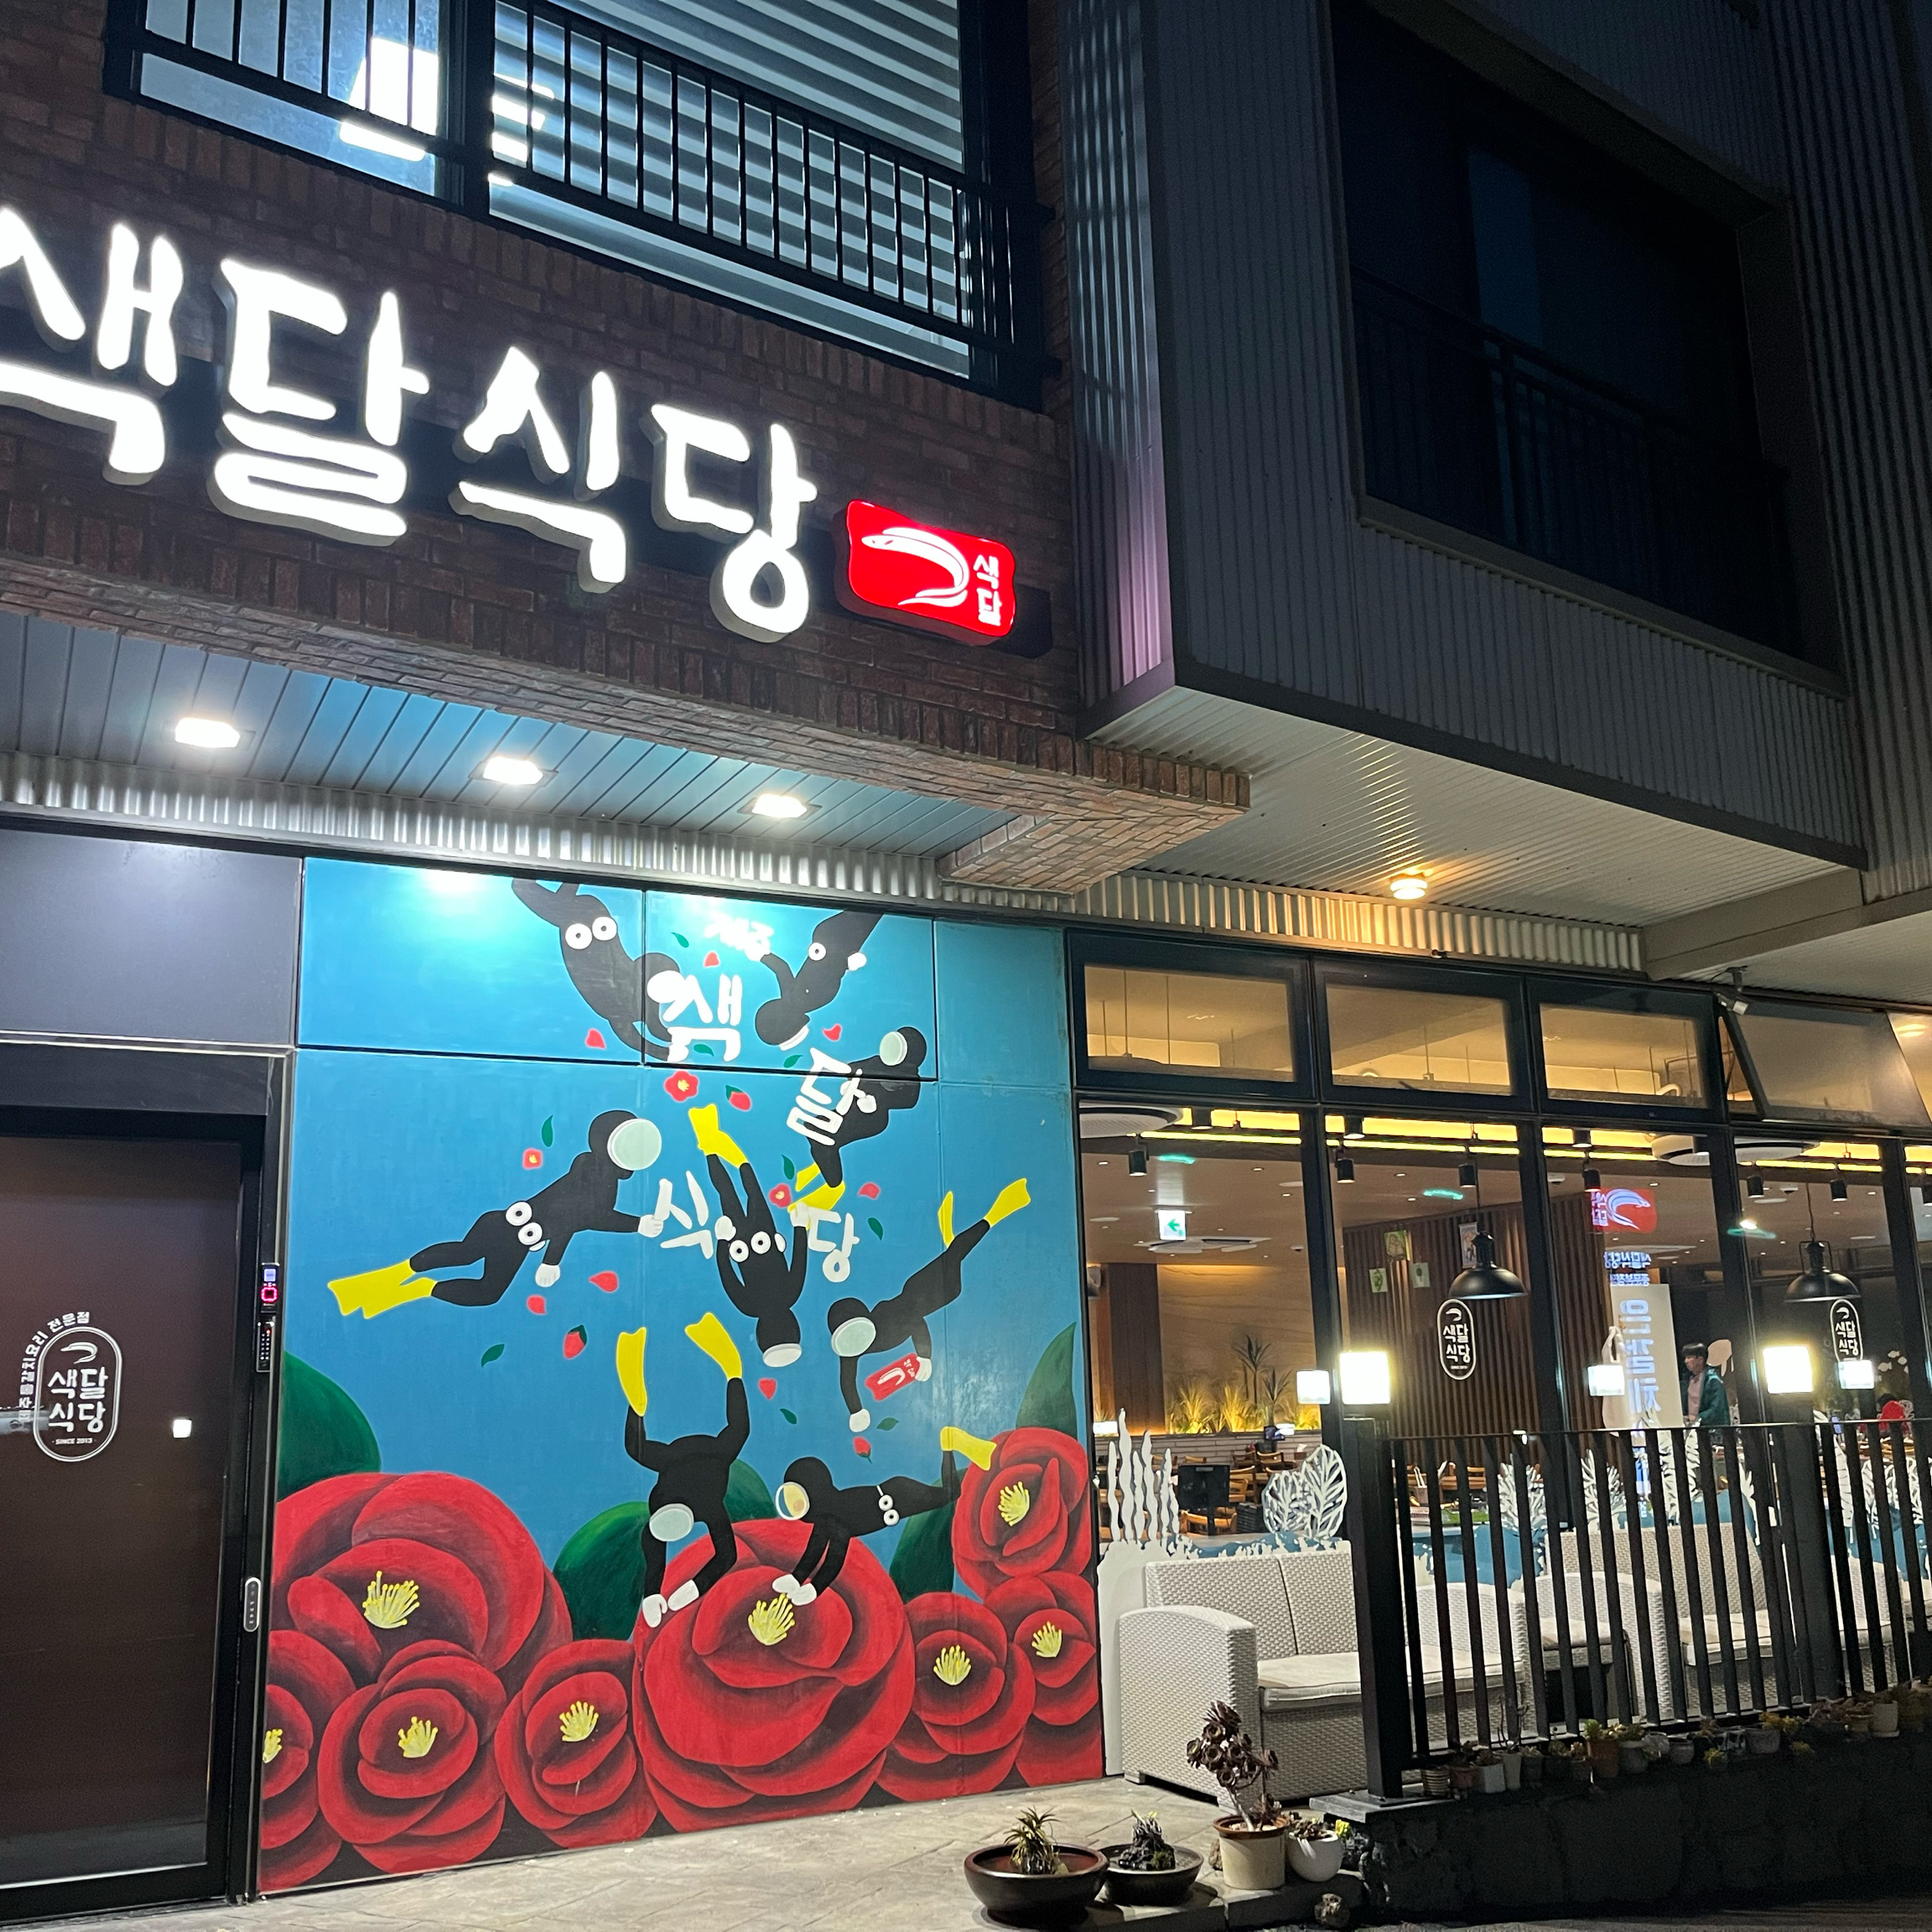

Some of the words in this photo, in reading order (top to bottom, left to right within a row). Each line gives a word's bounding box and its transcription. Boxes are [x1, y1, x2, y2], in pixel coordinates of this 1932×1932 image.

[0, 206, 818, 637] 색달식당
[973, 553, 1003, 626] 색달
[47, 1311, 91, 1332] 전문점
[1835, 1320, 1856, 1338] 색달
[1442, 1323, 1469, 1343] 색달
[1446, 1344, 1471, 1363] 식당
[1838, 1338, 1859, 1356] 식당
[48, 1366, 108, 1400] 색달
[48, 1401, 106, 1433] 식당
